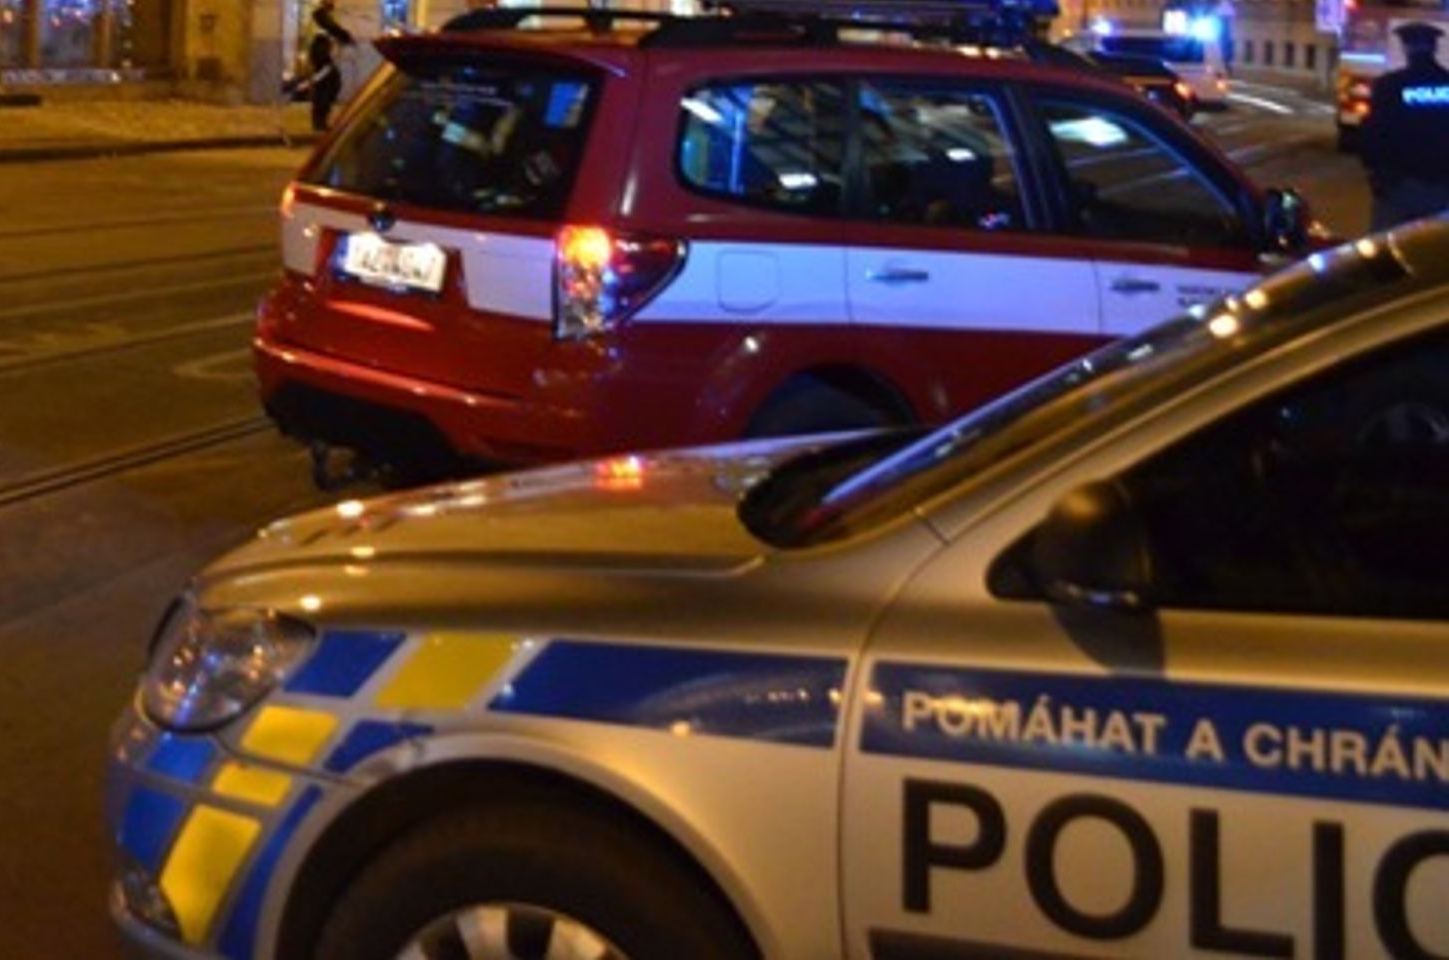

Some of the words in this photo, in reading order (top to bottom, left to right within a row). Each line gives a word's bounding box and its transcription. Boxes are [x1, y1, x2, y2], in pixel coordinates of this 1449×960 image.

[902, 691, 1167, 756] POMÁHAT
[1184, 719, 1225, 763] A
[1243, 723, 1449, 782] CHRÁN
[901, 776, 1449, 960] POLIC
